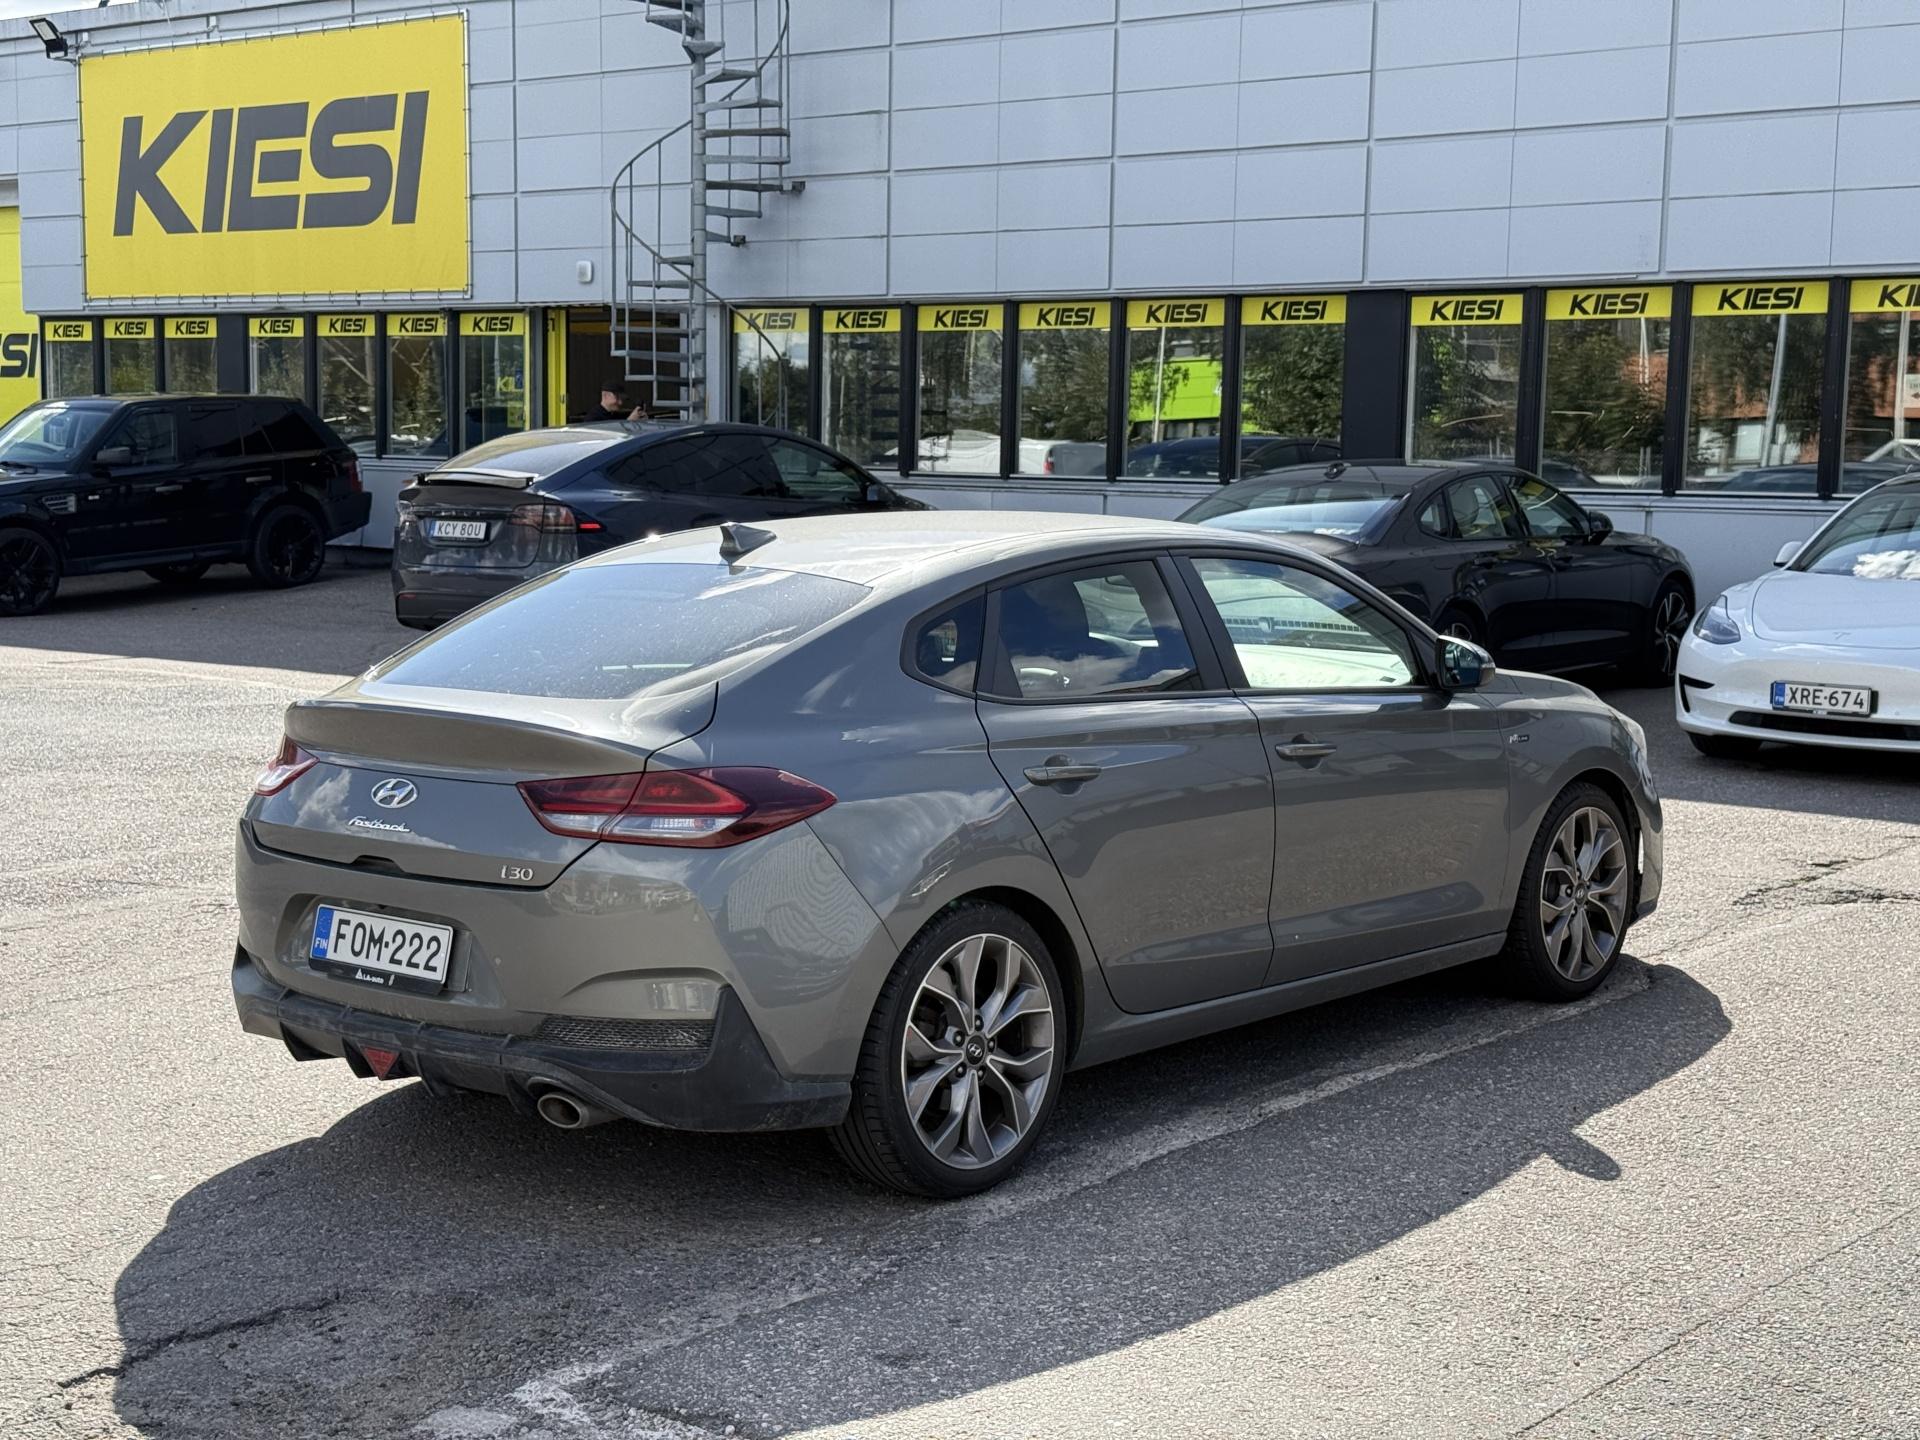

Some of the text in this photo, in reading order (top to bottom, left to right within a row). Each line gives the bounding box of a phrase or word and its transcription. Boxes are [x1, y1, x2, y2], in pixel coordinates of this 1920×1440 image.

[113, 90, 430, 237] KIESI
[1569, 292, 1649, 316] KIESI
[1718, 287, 1804, 310] KIESI
[934, 309, 989, 328] KIESI
[1037, 307, 1095, 326] KIESI
[1146, 303, 1208, 323] KIESI
[1261, 300, 1328, 321] KIESI
[1430, 300, 1504, 321] KIESI
[114, 321, 147, 336] KIESI
[175, 320, 209, 335] KIESI
[258, 319, 294, 334] KIESI
[329, 318, 366, 333] KIESI
[399, 317, 438, 333] KIESI
[472, 316, 513, 332] KIESI
[747, 312, 796, 330] KIESI
[835, 311, 887, 329] KIESI
[53, 324, 84, 338] KIESI
[0, 333, 38, 378] SI
[437, 522, 458, 536] KCY
[348, 815, 410, 832] Fastback
[314, 937, 328, 949] FIN
